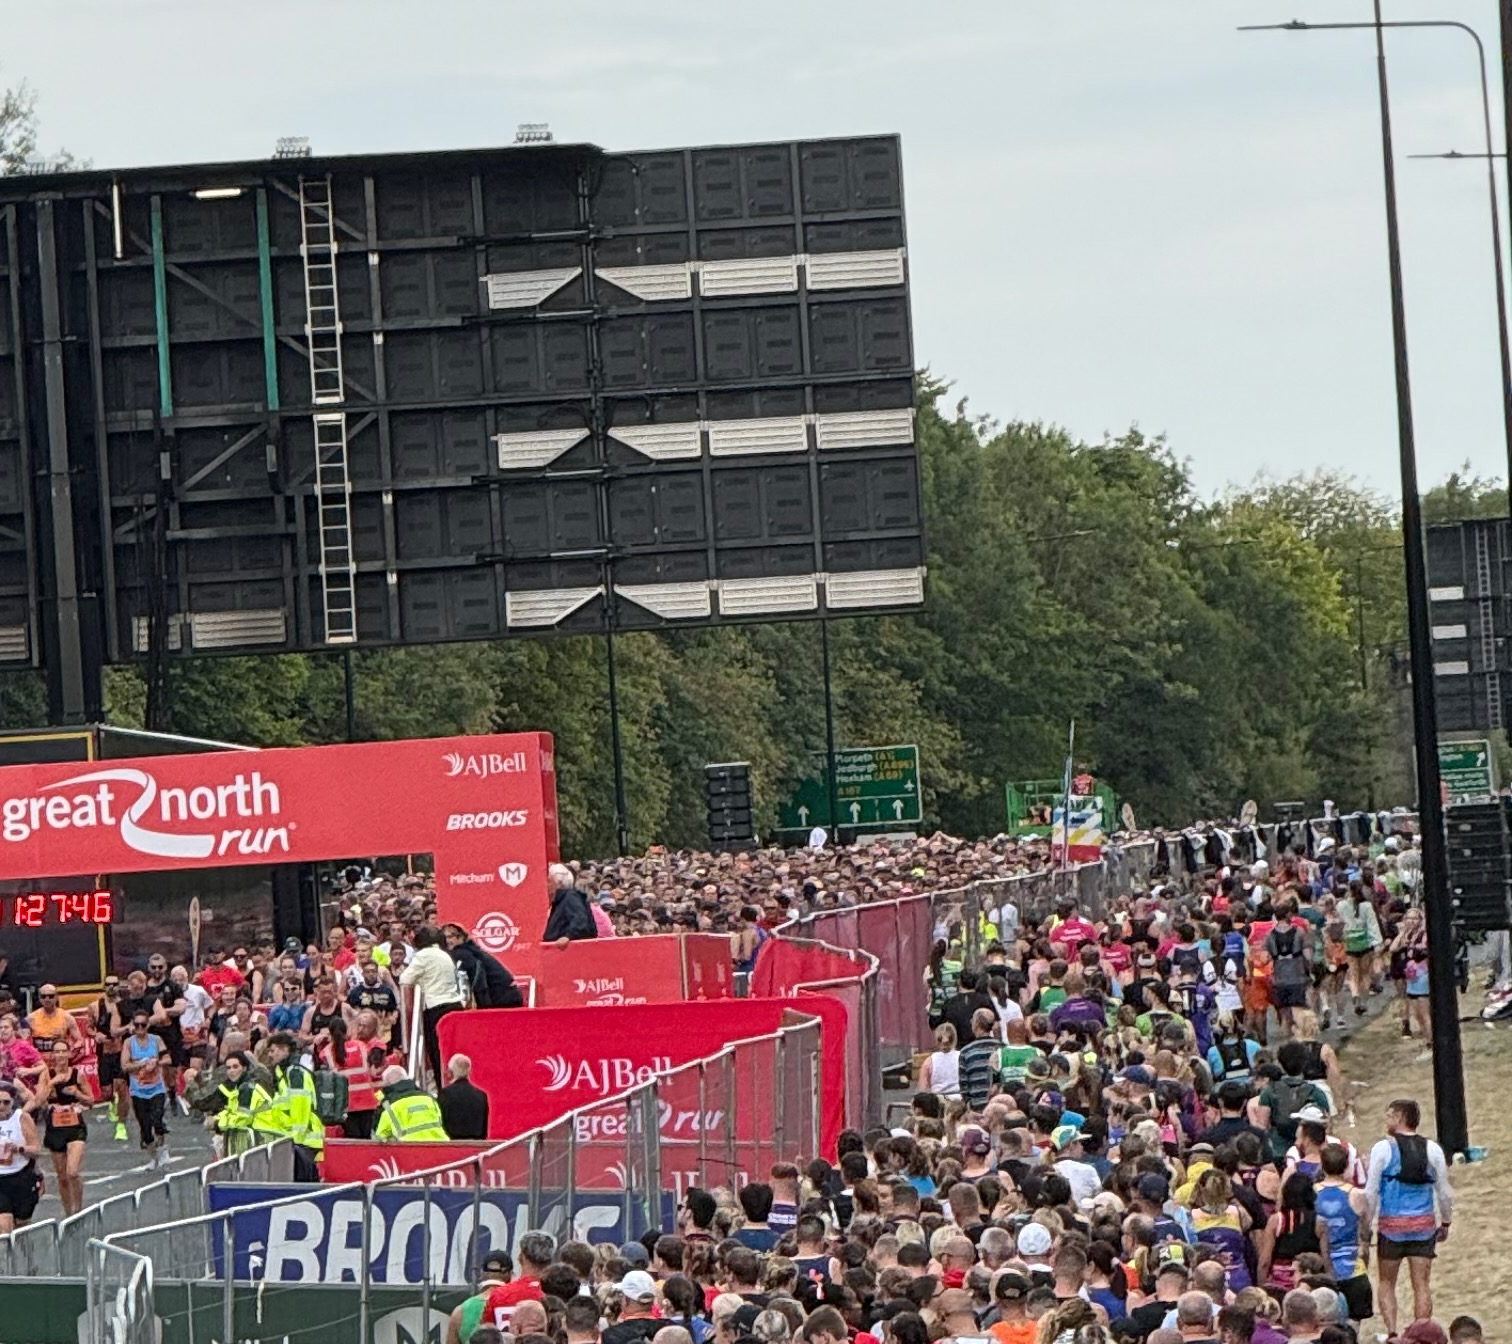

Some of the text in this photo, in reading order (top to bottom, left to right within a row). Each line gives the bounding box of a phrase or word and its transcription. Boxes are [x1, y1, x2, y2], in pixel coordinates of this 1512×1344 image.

[2, 783, 116, 842] great
[160, 771, 281, 822] north
[445, 809, 529, 831] BROOKS
[217, 827, 290, 856] run
